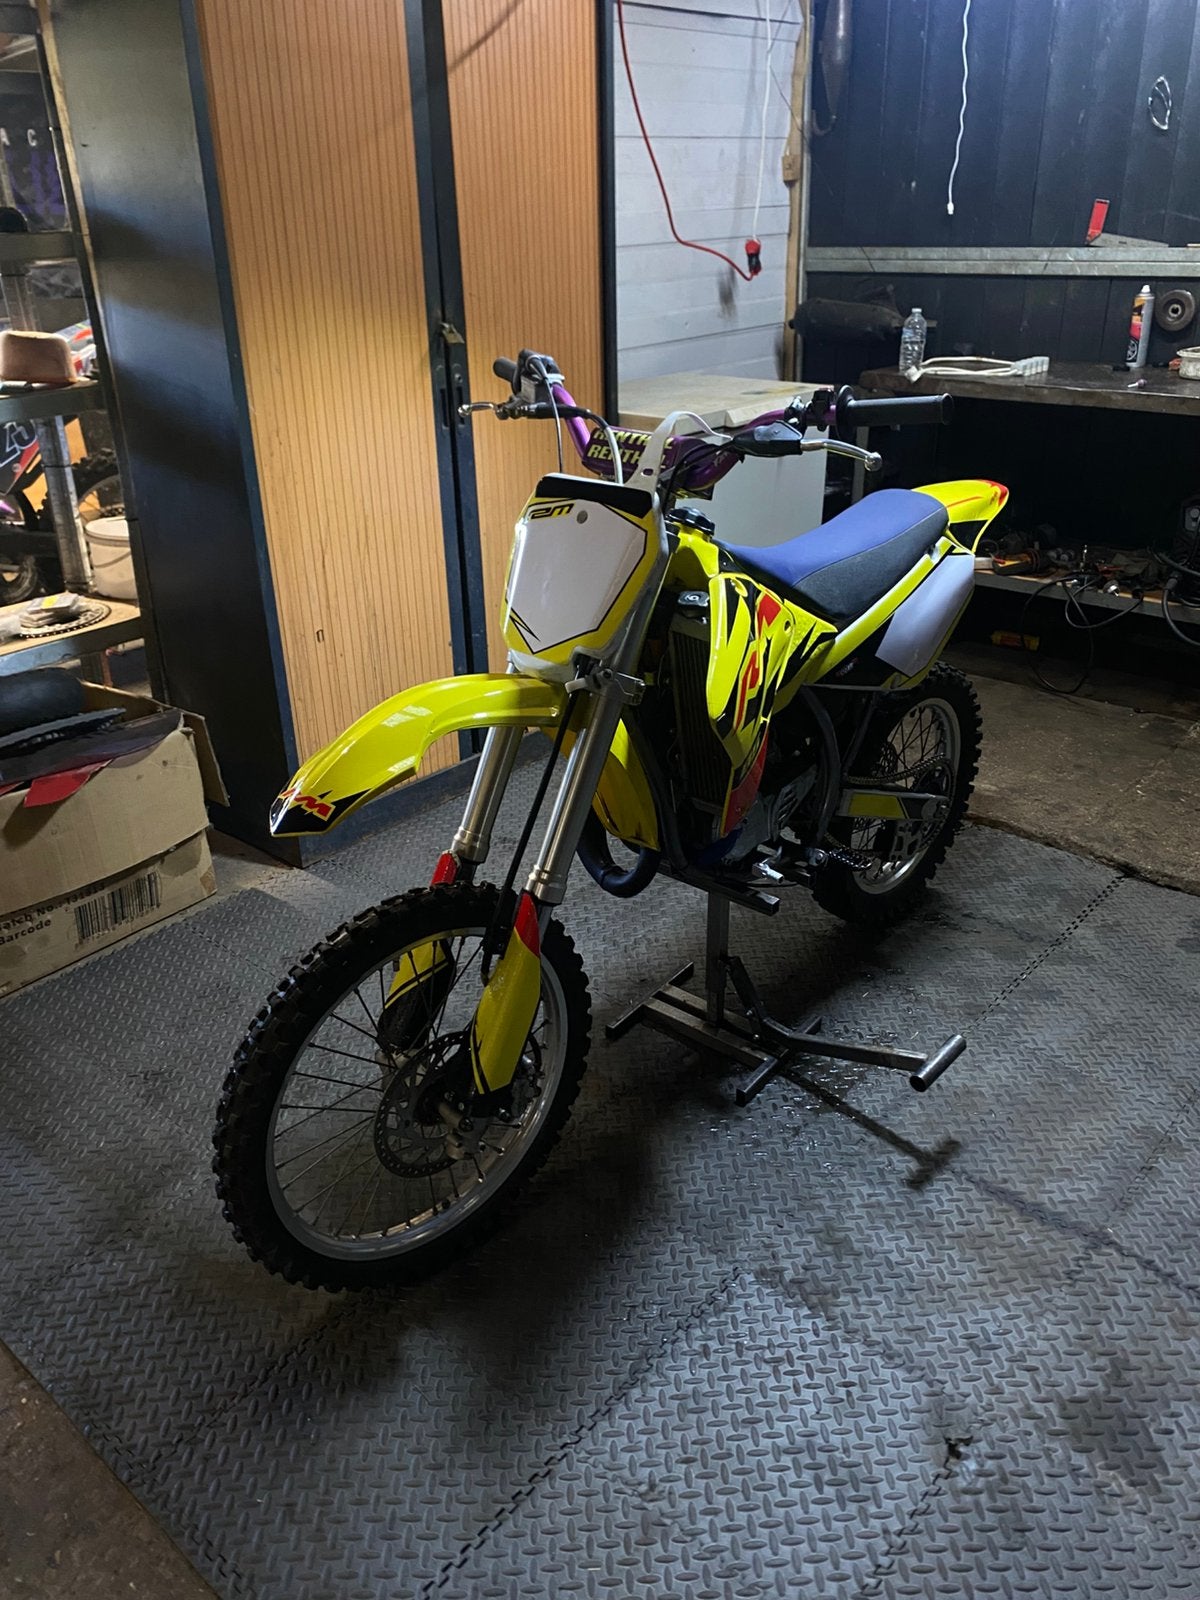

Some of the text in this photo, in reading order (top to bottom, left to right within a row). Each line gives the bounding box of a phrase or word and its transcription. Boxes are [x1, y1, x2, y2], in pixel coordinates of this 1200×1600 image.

[593, 429, 674, 449] RNTHL
[0, 912, 33, 931] atch
[0, 918, 51, 945] Barcode
